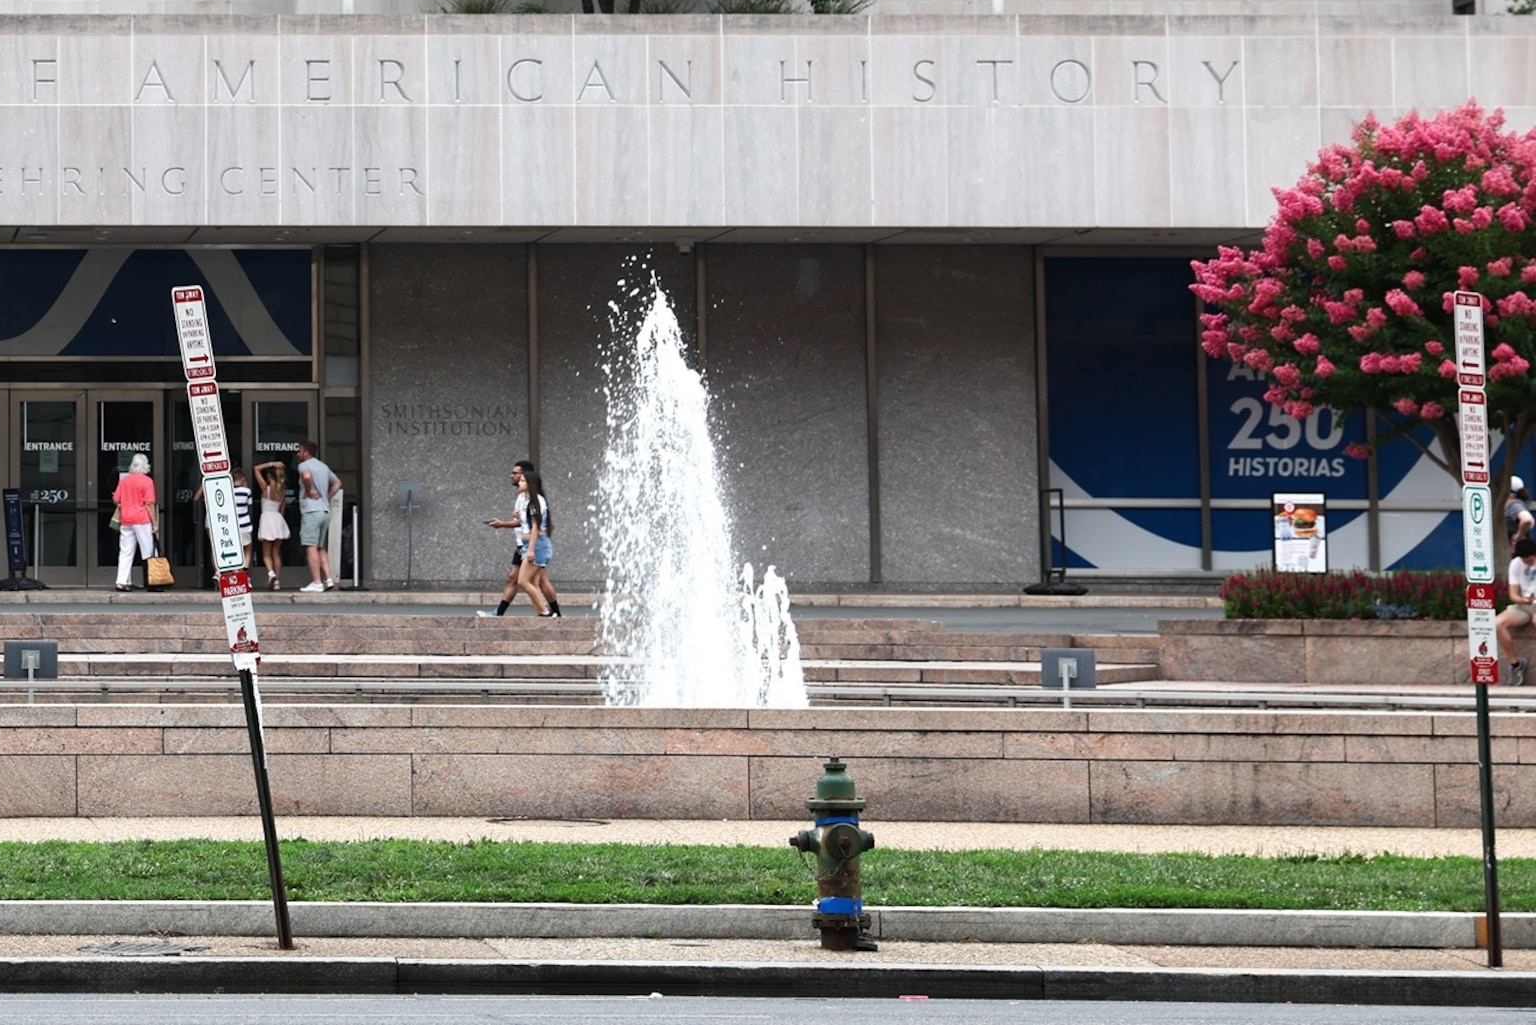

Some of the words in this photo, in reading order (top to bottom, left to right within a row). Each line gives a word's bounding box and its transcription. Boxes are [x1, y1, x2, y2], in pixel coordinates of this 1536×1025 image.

[133, 59, 695, 104] AMERICAN
[779, 59, 1241, 104] HISTORY
[220, 166, 427, 196] CENTER
[381, 404, 518, 419] SMITHSONIAN
[389, 421, 512, 436] INSTITUTION
[1227, 397, 1344, 450] 250
[26, 442, 74, 451] ENTRANCE
[103, 442, 151, 451] ENTRANCE
[259, 443, 300, 452] ENTRANC
[1228, 457, 1345, 477] HISTORIAS
[40, 489, 69, 504] 250
[217, 513, 229, 523] Pay
[221, 527, 229, 536] To
[220, 539, 234, 548] Park
[229, 576, 238, 585] NO
[223, 584, 247, 596] PARKING
[1476, 588, 1485, 598] NO
[1470, 598, 1493, 609] PARKING
